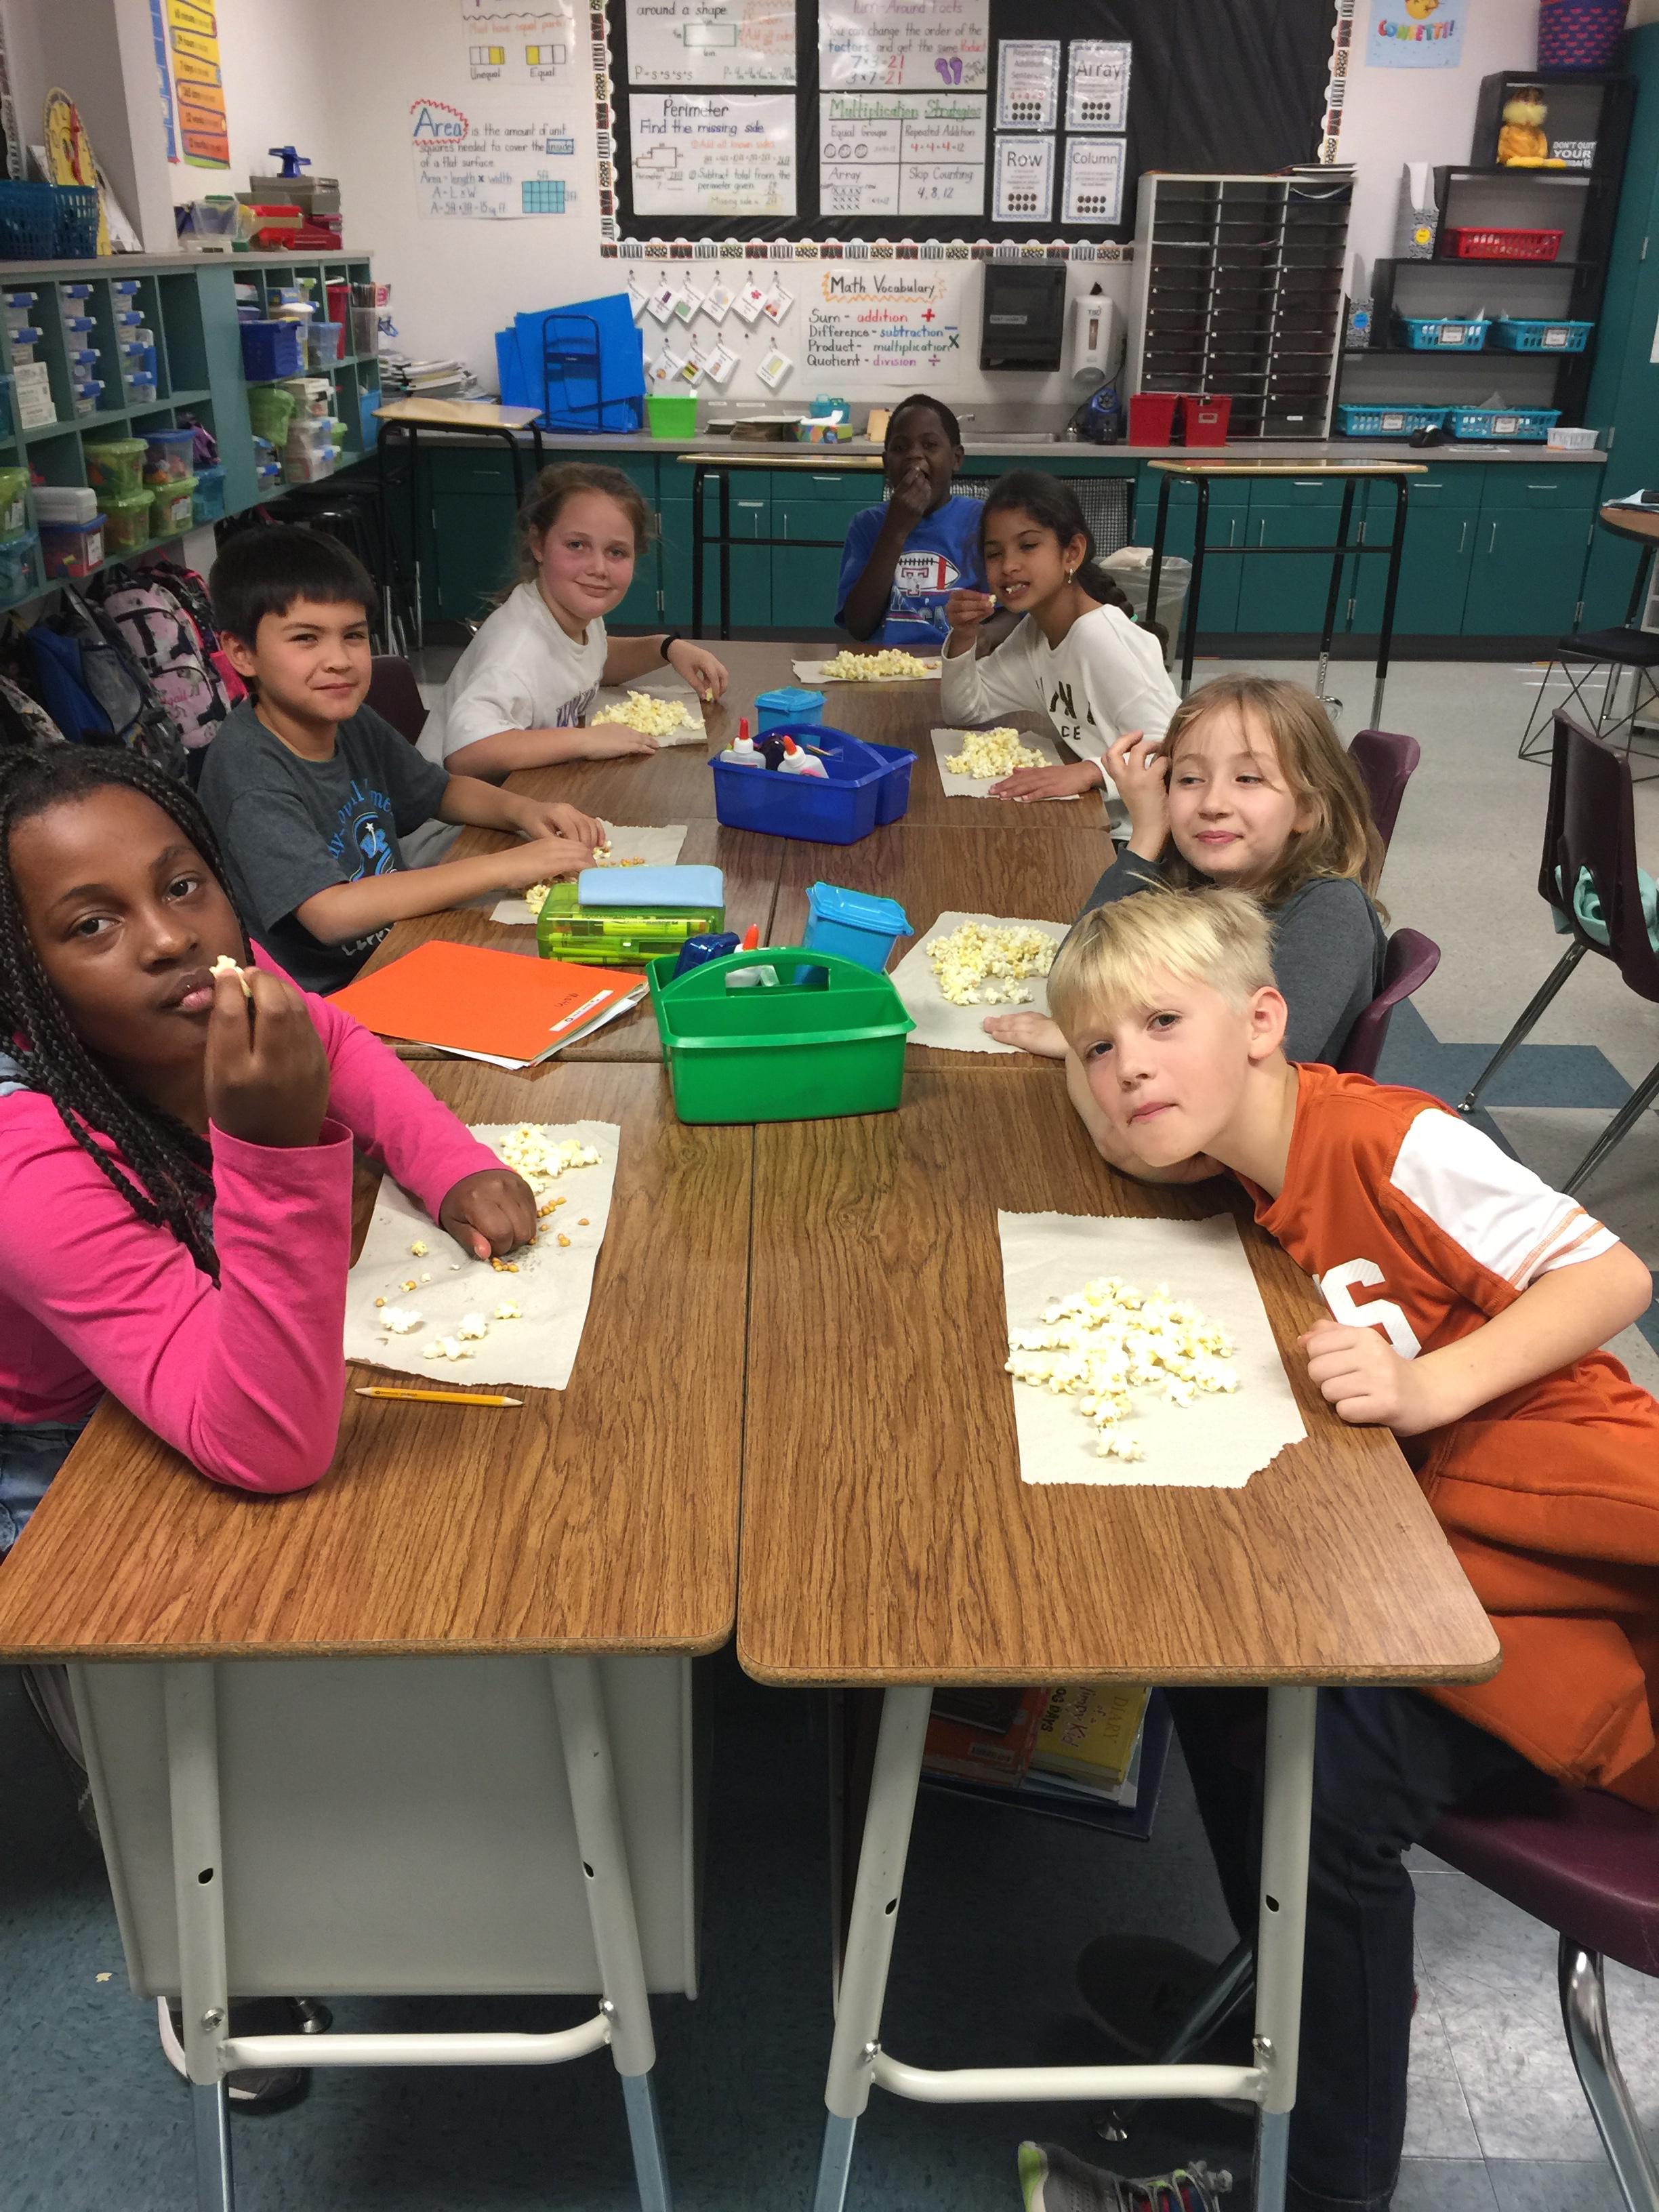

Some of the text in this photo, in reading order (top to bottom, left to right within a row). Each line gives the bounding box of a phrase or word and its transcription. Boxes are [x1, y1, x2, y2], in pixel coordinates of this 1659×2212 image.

[637, 4, 727, 19] around a shape
[868, 22, 900, 41] change
[905, 22, 921, 36] the
[924, 23, 951, 36] order
[956, 24, 965, 36] of
[968, 22, 982, 36] the
[828, 41, 869, 52] factors
[876, 43, 893, 52] and
[897, 43, 912, 56] get
[918, 41, 934, 52] the
[470, 67, 554, 81] Unequal Equal
[1076, 64, 1120, 81] Array
[663, 100, 729, 117] Perimeter
[830, 100, 981, 125] Multiplication Strategies
[413, 108, 567, 136] Area is the amount of unit
[640, 120, 765, 136] Find the missing side
[832, 125, 888, 140] Equal Groups
[905, 125, 976, 138] Repeated Addition
[419, 144, 454, 156] squares
[457, 141, 486, 152] needed
[491, 143, 500, 152] to
[531, 140, 544, 152] the
[548, 141, 572, 151] inside
[1578, 141, 1597, 150] QUIT
[1007, 151, 1043, 167] Row
[1073, 152, 1117, 164] Column
[1554, 150, 1591, 158] YOUR
[420, 157, 429, 167] of
[443, 157, 457, 167] flat
[462, 157, 493, 167] surface
[420, 171, 442, 184] Area
[450, 171, 475, 185] length
[489, 171, 512, 183] width
[699, 167, 791, 180] Subtract total from the
[829, 168, 861, 183] Array
[909, 169, 973, 183] Skip Counting
[697, 180, 731, 192] perimeter
[943, 188, 954, 198] 12
[830, 274, 935, 298] Math Vocabulary
[808, 308, 908, 323] Sum addition
[809, 325, 943, 337] Difference subtraction
[808, 339, 950, 356] Product multiplication
[806, 354, 916, 367] Quotient division
[1040, 1687, 1067, 1733] OG DAYS
[1105, 1696, 1128, 1744] DIARY
[1061, 1722, 1088, 1748] Kid
